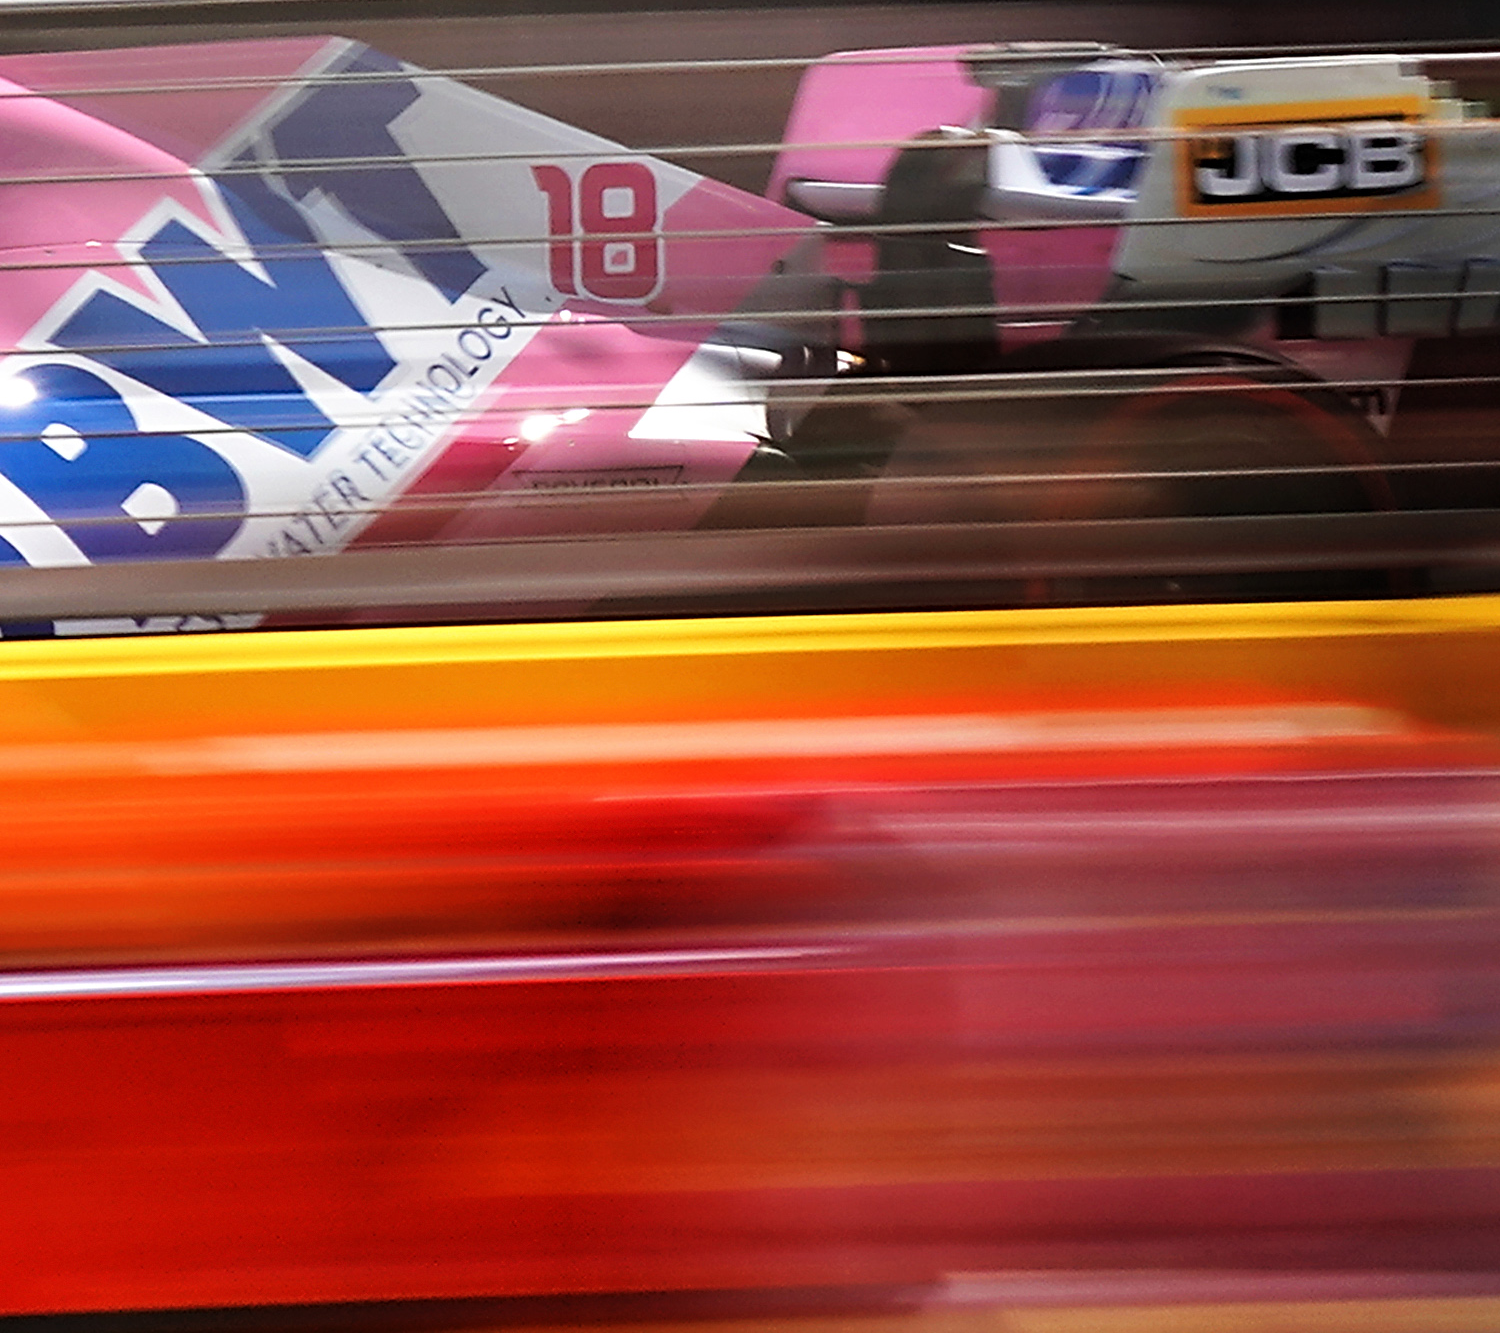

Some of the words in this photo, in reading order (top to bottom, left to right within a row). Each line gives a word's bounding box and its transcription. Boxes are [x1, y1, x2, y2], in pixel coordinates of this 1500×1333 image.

[1193, 124, 1426, 196] JCB
[529, 161, 658, 300] 18
[262, 467, 373, 559] ATER
[354, 285, 527, 483] TECHNOLOGY
